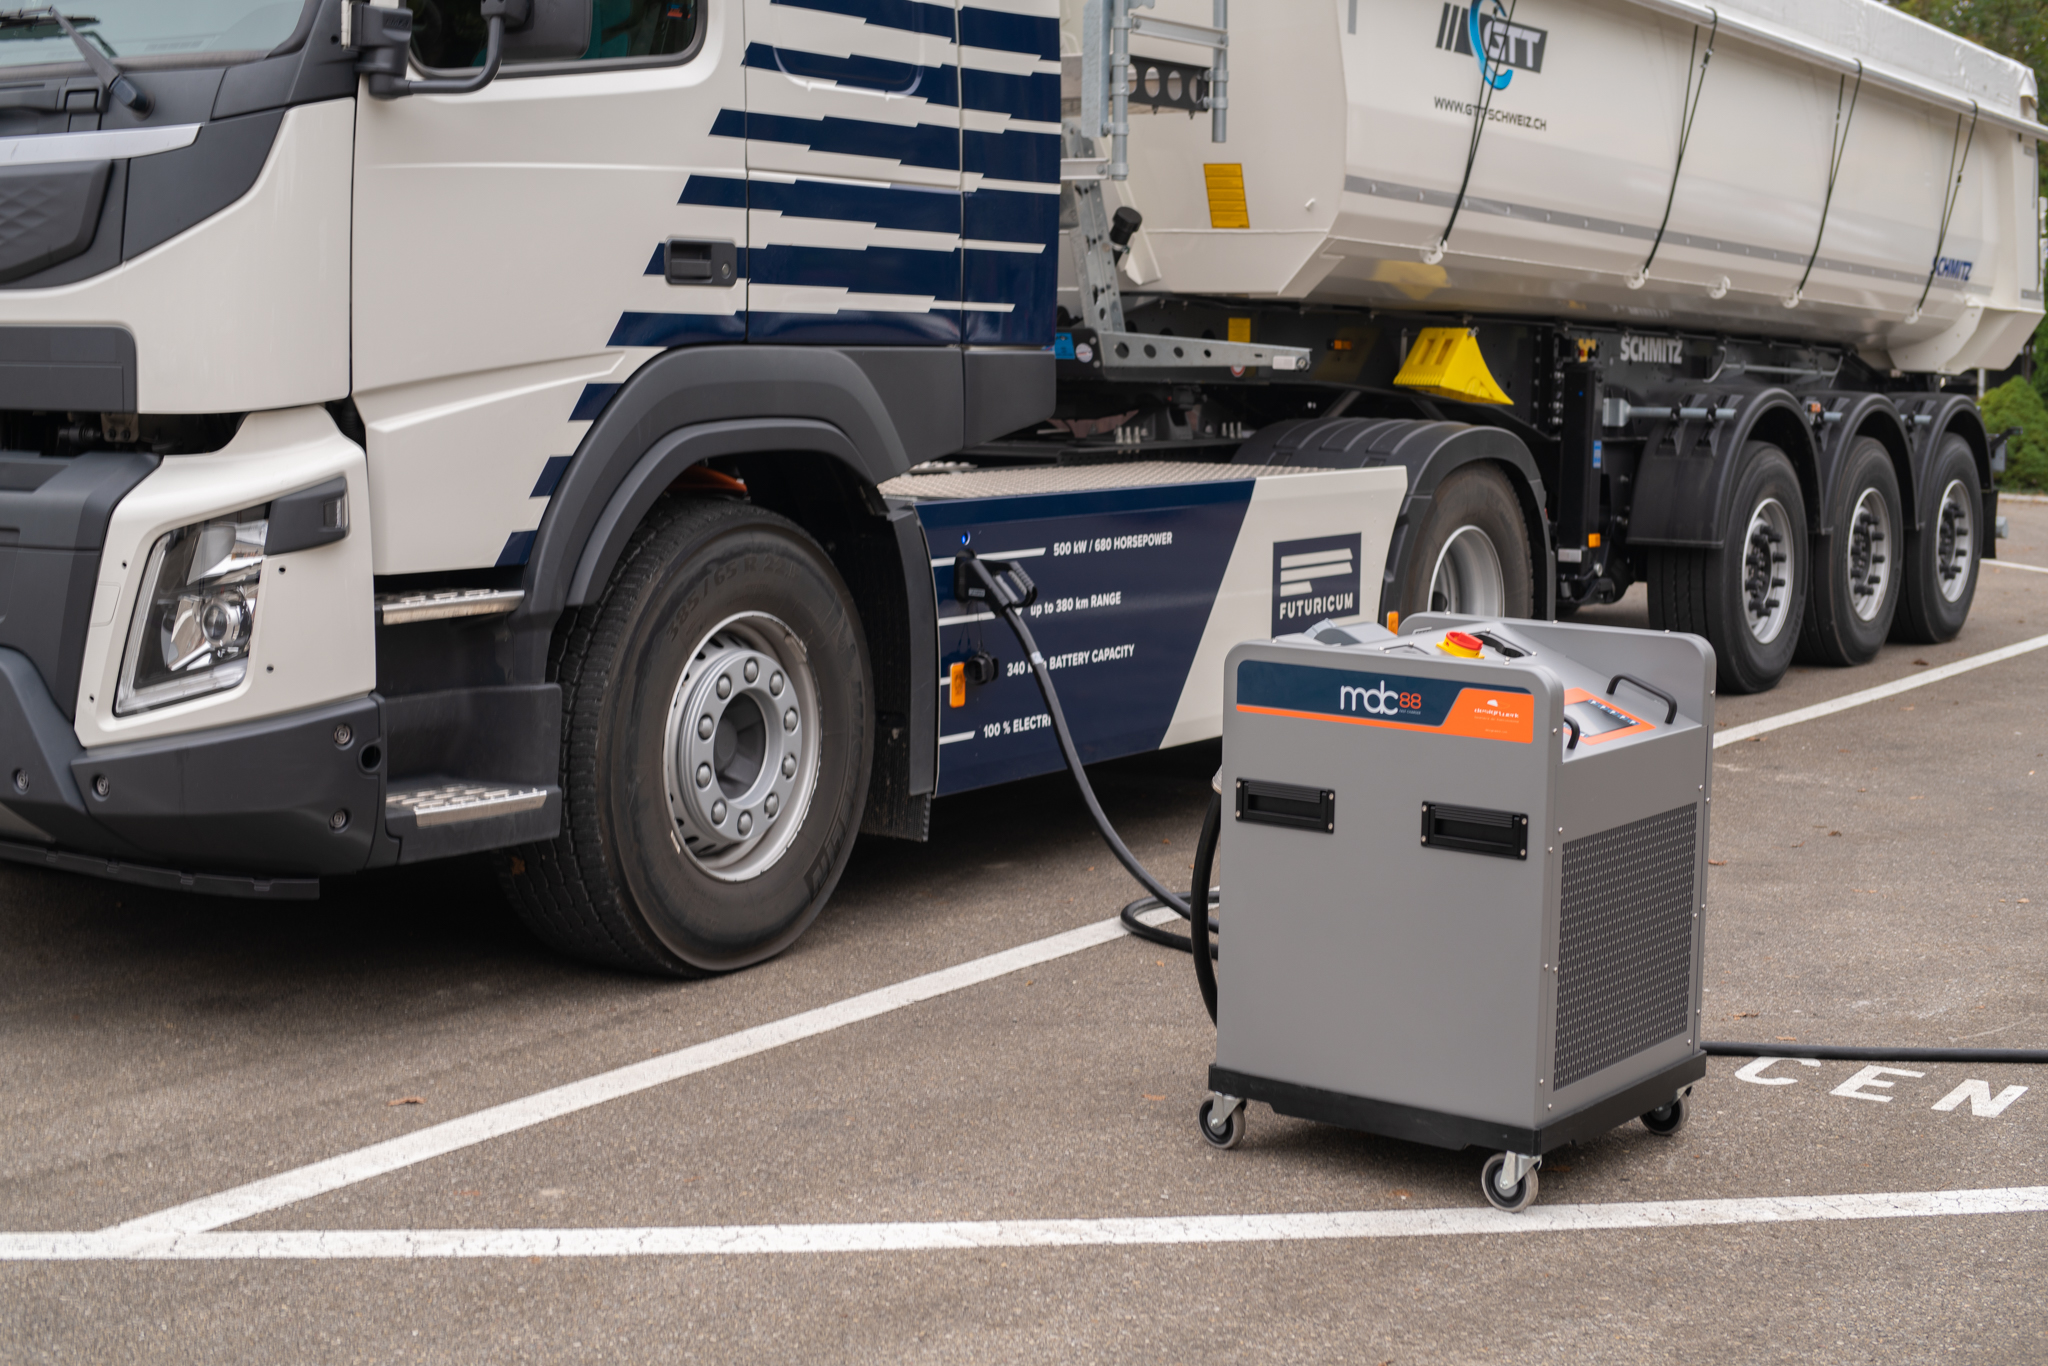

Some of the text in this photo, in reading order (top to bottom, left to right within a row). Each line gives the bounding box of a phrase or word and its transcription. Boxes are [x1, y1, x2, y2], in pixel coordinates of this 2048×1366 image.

[1484, 20, 1541, 68] GTT
[1434, 96, 1547, 131] WWW.GTTSCHWEIZ.CH
[1620, 334, 1683, 364] SCHMITZ
[1053, 531, 1173, 557] 500 kW / 680 HORSEPOWER
[1030, 591, 1121, 618] up to 380 km RANGE
[1279, 592, 1353, 620] FUTURICUM
[1006, 661, 1026, 677] 340
[1049, 650, 1090, 671] BATTERY
[1091, 643, 1135, 663] CAPACITY
[983, 722, 1001, 739] 100
[1002, 720, 1011, 735] %
